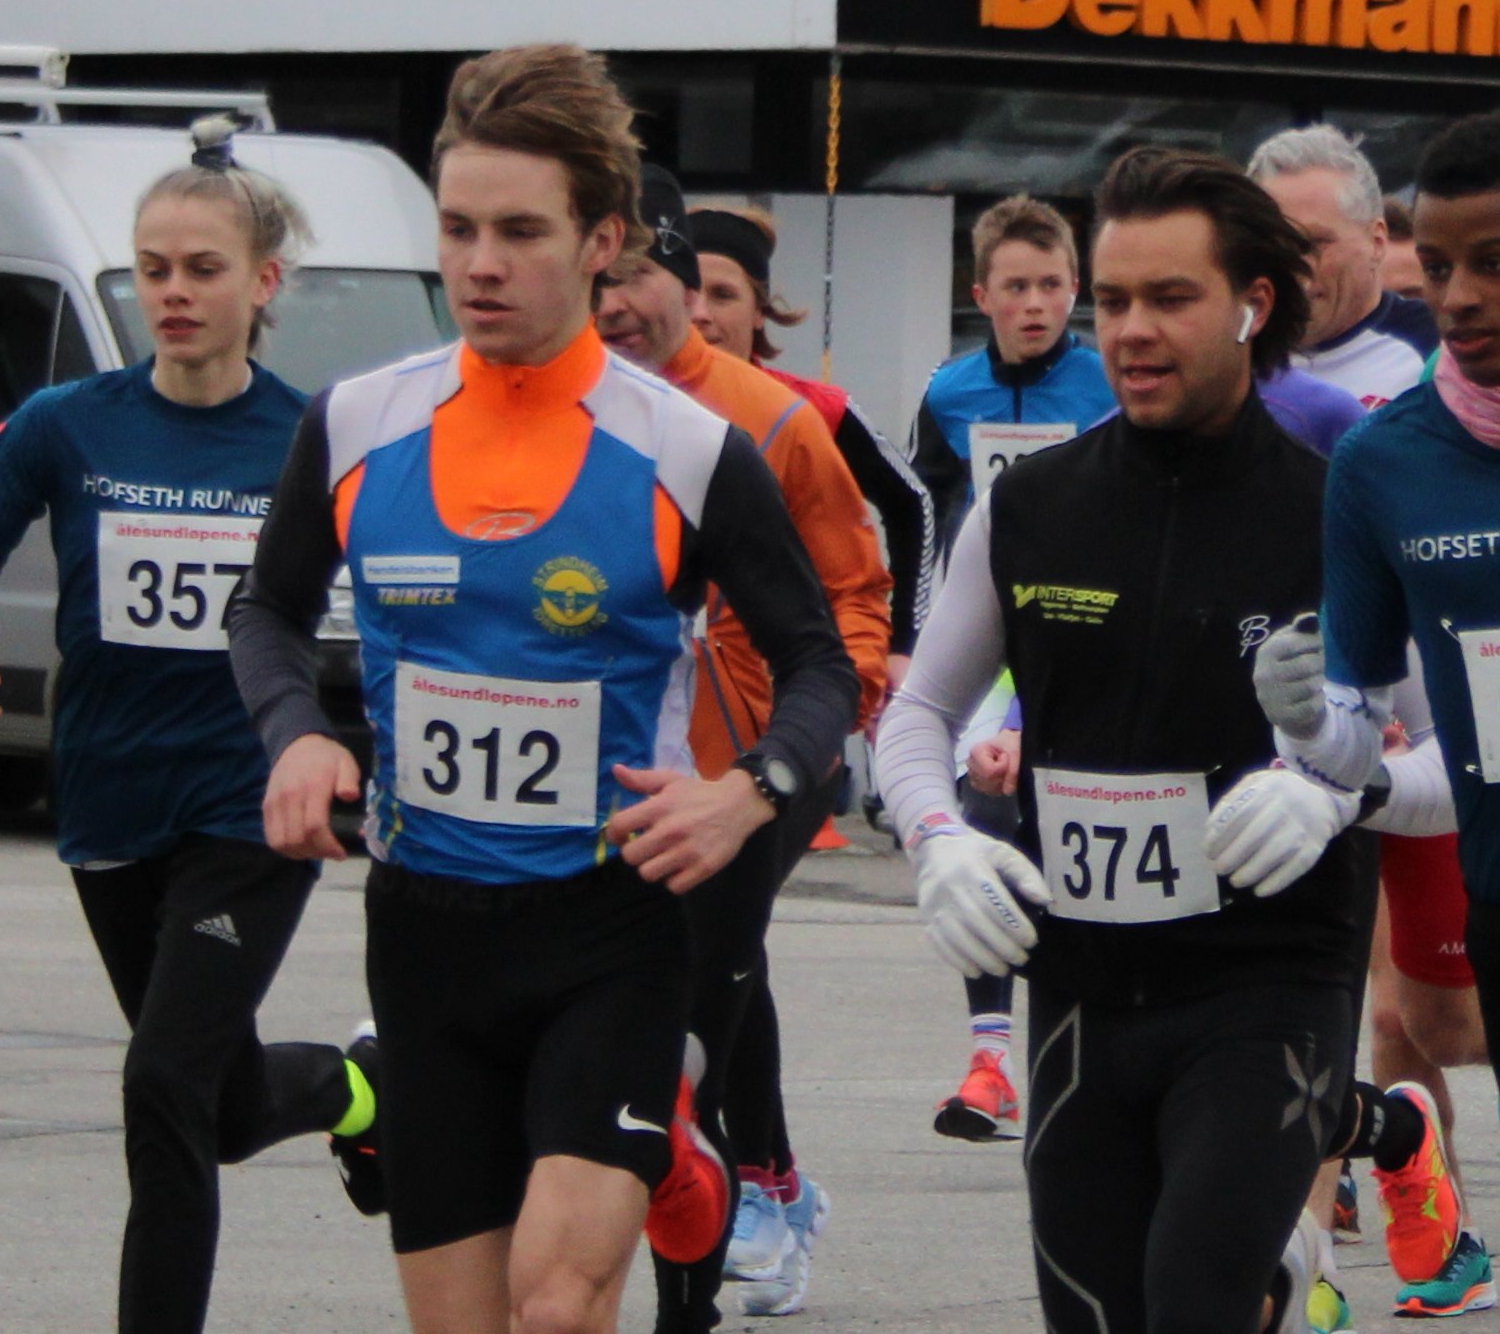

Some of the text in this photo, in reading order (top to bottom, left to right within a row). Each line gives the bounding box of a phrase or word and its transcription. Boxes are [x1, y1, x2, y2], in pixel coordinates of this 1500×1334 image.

[83, 473, 273, 516] HOFSETH RUNNE
[115, 523, 261, 543] ålesundløpene.n
[126, 559, 254, 632] 357
[377, 587, 459, 605] TRIMTEX
[1037, 585, 1120, 607] INTERSPORT
[422, 719, 561, 805] 312
[1062, 821, 1181, 901] 374
[194, 923, 241, 947] adidas
